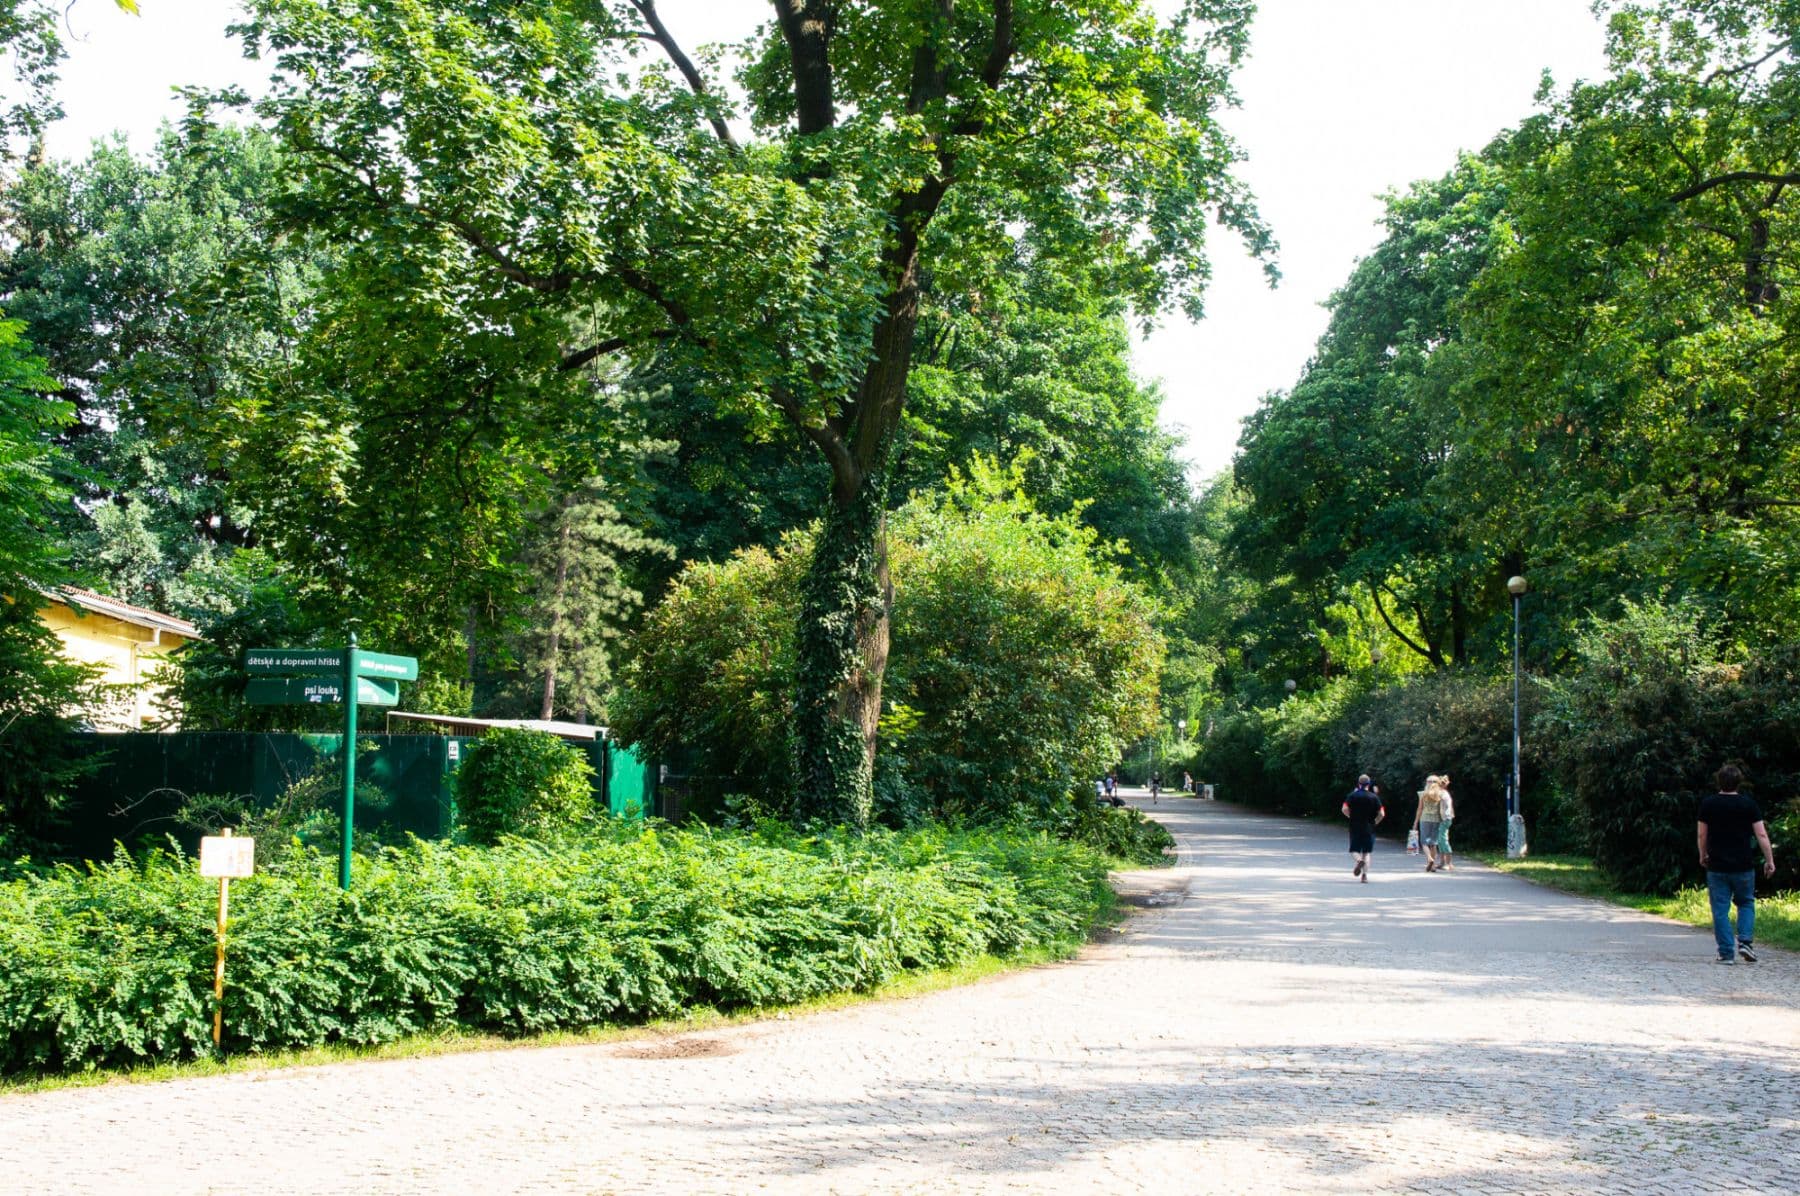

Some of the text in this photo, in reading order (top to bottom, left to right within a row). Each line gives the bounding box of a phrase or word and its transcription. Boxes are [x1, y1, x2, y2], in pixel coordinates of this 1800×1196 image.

[247, 657, 274, 666] dětské
[281, 657, 317, 667] dopravní
[318, 657, 340, 666] hřiště
[317, 685, 338, 695] louka
